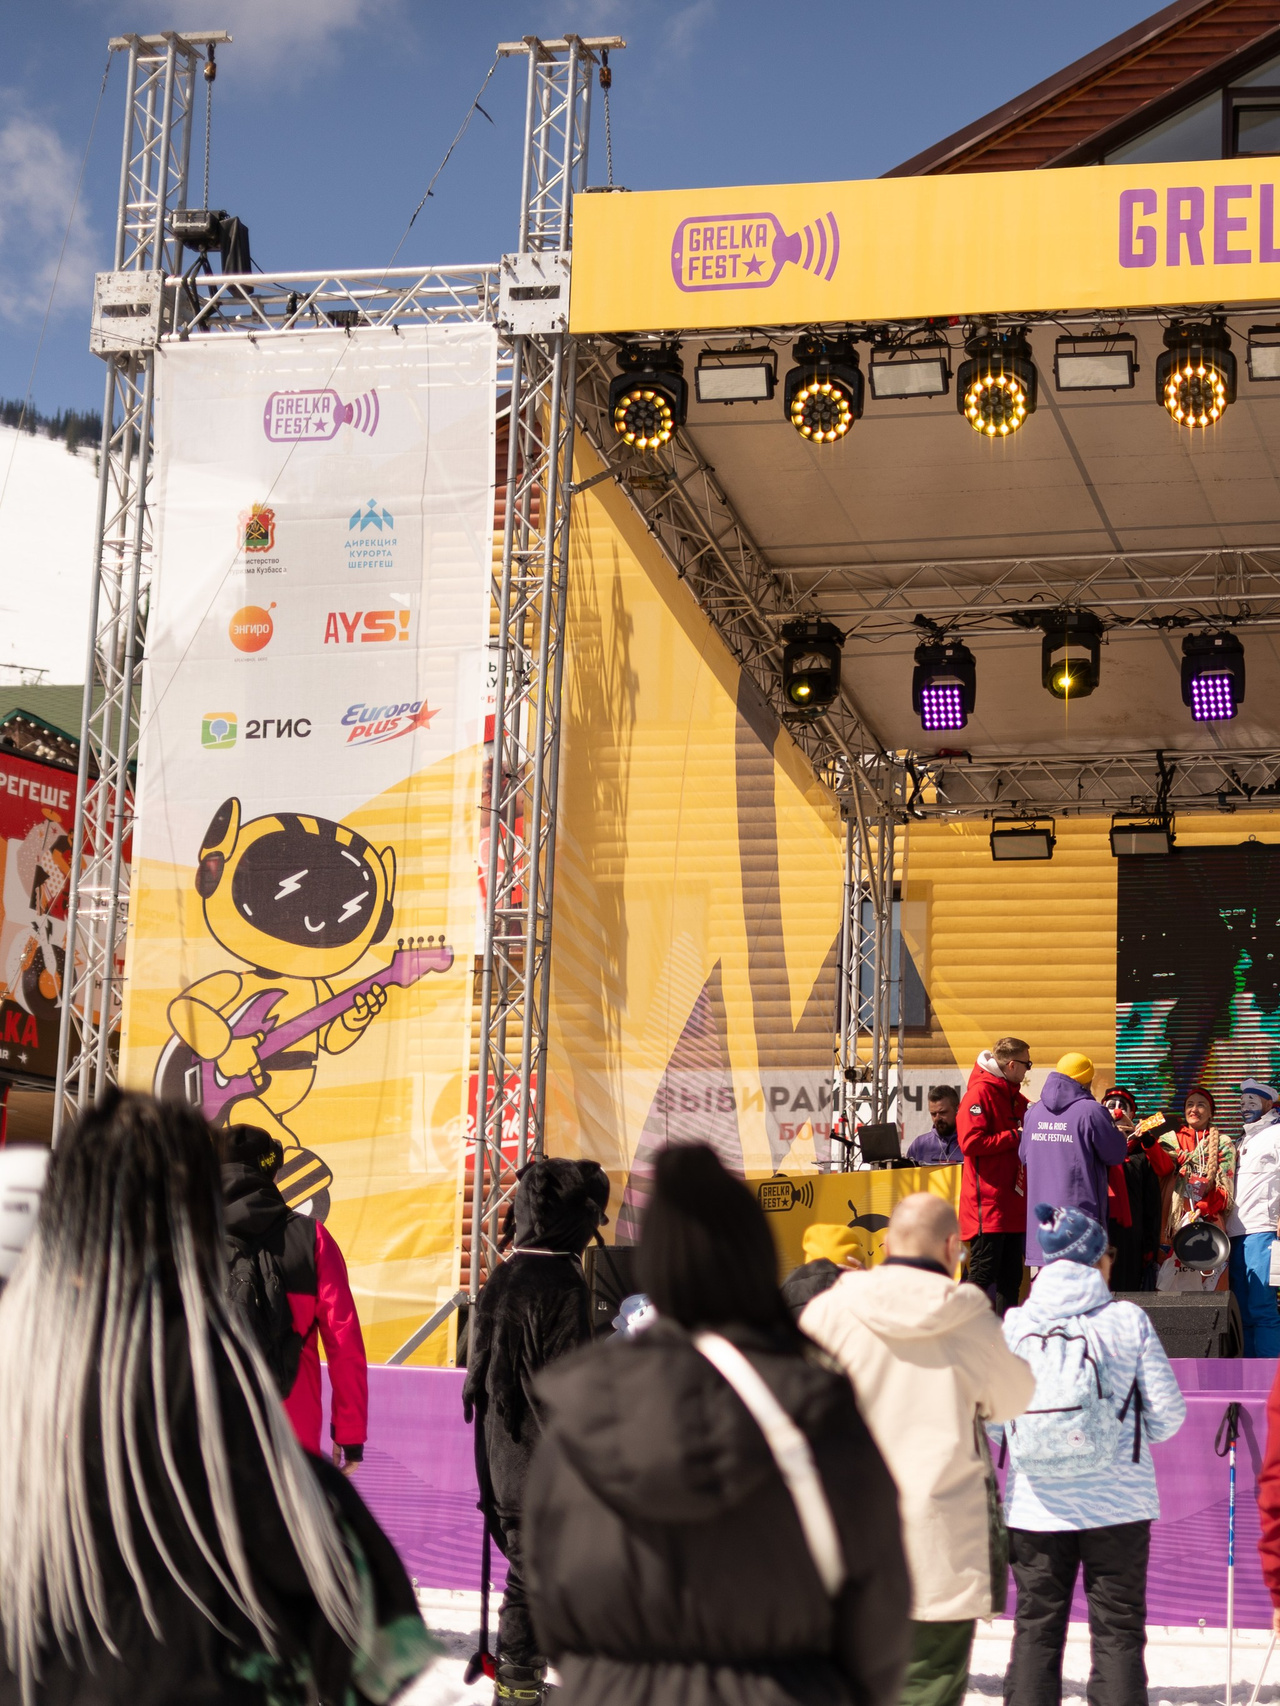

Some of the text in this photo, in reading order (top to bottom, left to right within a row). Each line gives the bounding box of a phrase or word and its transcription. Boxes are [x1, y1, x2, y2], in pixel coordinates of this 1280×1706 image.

[689, 223, 767, 252] GRELKA
[688, 254, 741, 281] FEST
[276, 397, 330, 415] GRELKA
[275, 417, 312, 434] FEST
[344, 538, 397, 549] ДИРЕКЦИЯ
[349, 549, 393, 558] КУРОРТА
[256, 566, 287, 576] Кузбасса
[348, 560, 393, 569] ШЕРЕГЕШ
[233, 623, 270, 637] энгиро
[324, 610, 411, 644] AYS!
[341, 701, 423, 726] Europa
[245, 718, 312, 740] 2ГИС
[763, 1185, 790, 1197] GRELKA
[763, 1198, 781, 1208] FEST
